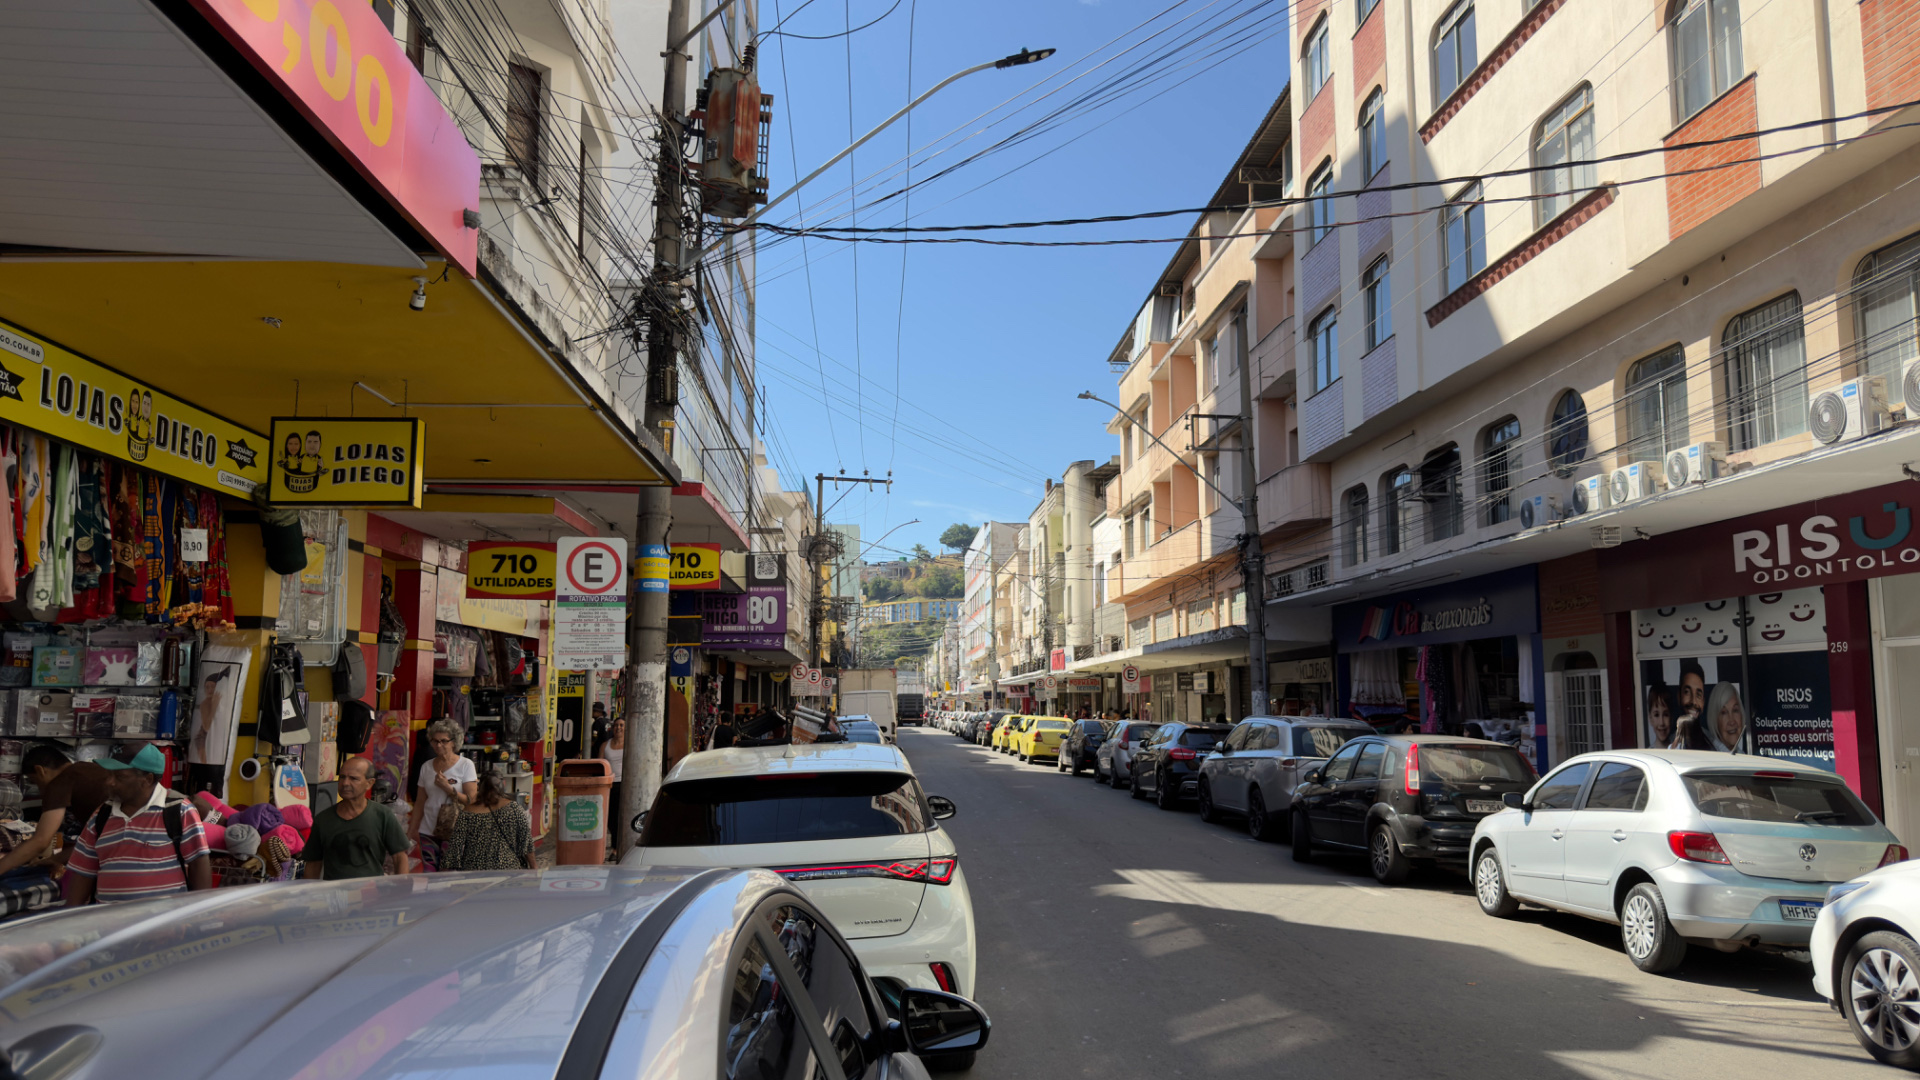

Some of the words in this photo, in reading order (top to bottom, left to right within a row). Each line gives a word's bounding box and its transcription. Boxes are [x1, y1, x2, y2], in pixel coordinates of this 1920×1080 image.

[242, 0, 393, 147] ,00
[40, 366, 124, 435] LOJAS
[156, 413, 217, 468] DIEGO
[334, 443, 405, 463] LOJAS
[332, 466, 405, 486] DIEGO
[491, 554, 537, 574] 710
[584, 553, 603, 582] E
[670, 571, 714, 579] LIDADES
[474, 577, 553, 588] UTILIDADES
[698, 598, 738, 611] PREÇO
[747, 596, 778, 624] 80
[704, 611, 738, 624] NICO
[1393, 600, 1421, 636] Cia
[1435, 597, 1491, 630] enxovais
[1830, 642, 1848, 653] 259
[812, 672, 816, 680] E
[1128, 669, 1134, 679] E
[1755, 717, 1792, 730] Soluções
[1757, 734, 1779, 746] para
[1807, 730, 1834, 742] sorris
[1760, 748, 1774, 756] em
[1790, 747, 1813, 758] único
[1814, 748, 1836, 760] luga
[1786, 906, 1819, 918] HFM5
